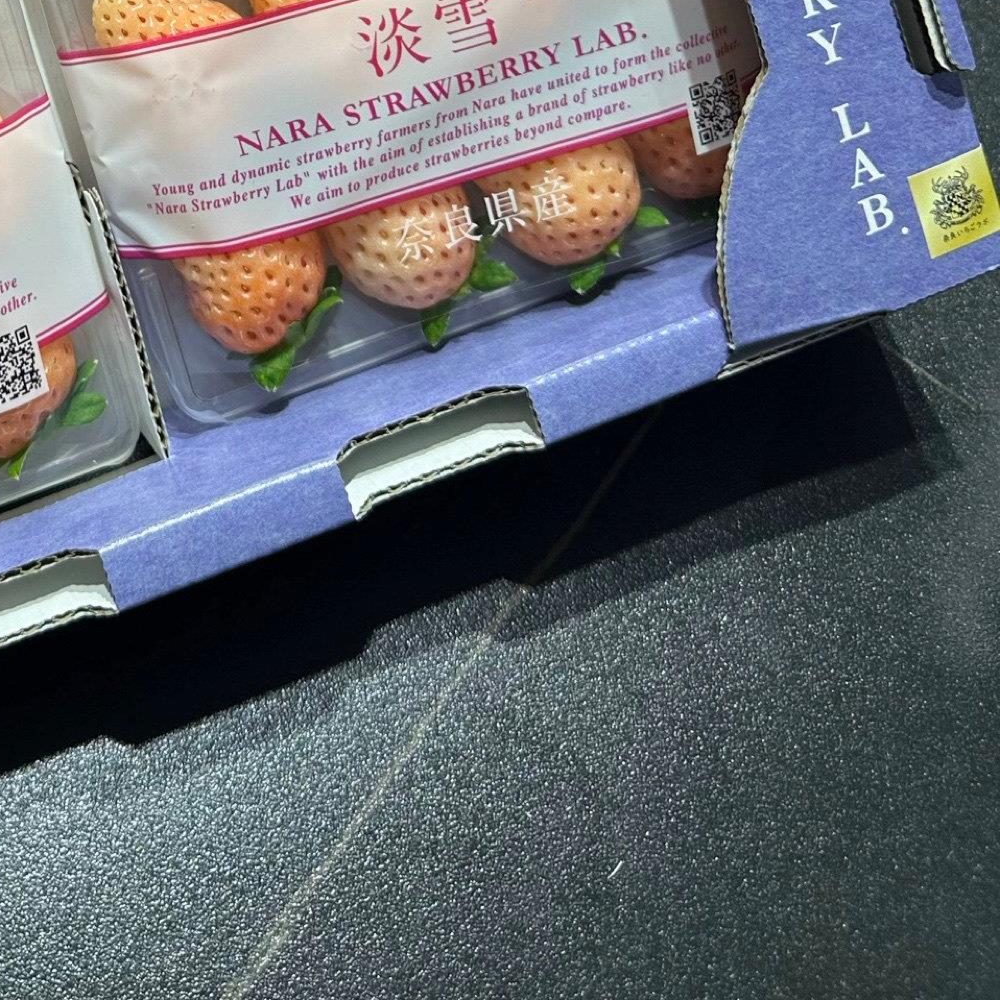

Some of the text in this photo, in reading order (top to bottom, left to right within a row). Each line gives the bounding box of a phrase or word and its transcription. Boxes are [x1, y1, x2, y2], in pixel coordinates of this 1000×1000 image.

[152, 182, 195, 198] Young
[199, 173, 227, 191] and
[232, 158, 290, 185] dynamic
[296, 137, 372, 166] strawberry
[377, 120, 431, 147] farmers
[434, 107, 468, 129] from
[472, 96, 506, 113] Nara
[511, 84, 542, 101] have
[547, 66, 590, 91] united
[595, 65, 608, 76] to
[612, 54, 647, 75] form
[650, 46, 670, 60] the
[191, 185, 270, 212] Strawberry
[275, 171, 309, 192] Lab"
[317, 162, 348, 180] with
[353, 156, 374, 171] the
[380, 147, 405, 163] aim
[409, 137, 424, 154] of
[428, 115, 510, 147] establishing
[515, 110, 523, 120] a
[528, 94, 568, 117] brand
[573, 88, 587, 104] of
[592, 69, 665, 98] strawberry
[669, 60, 692, 75] like
[697, 54, 711, 65] no
[234, 22, 647, 157] NARA STRAWBERRY LAB.
[289, 101, 631, 208] We aim to produce strawberries beyond compare.
[393, 167, 577, 269] 奈良県産
[831, 102, 909, 236] LAB.
[0, 292, 37, 315] other.
